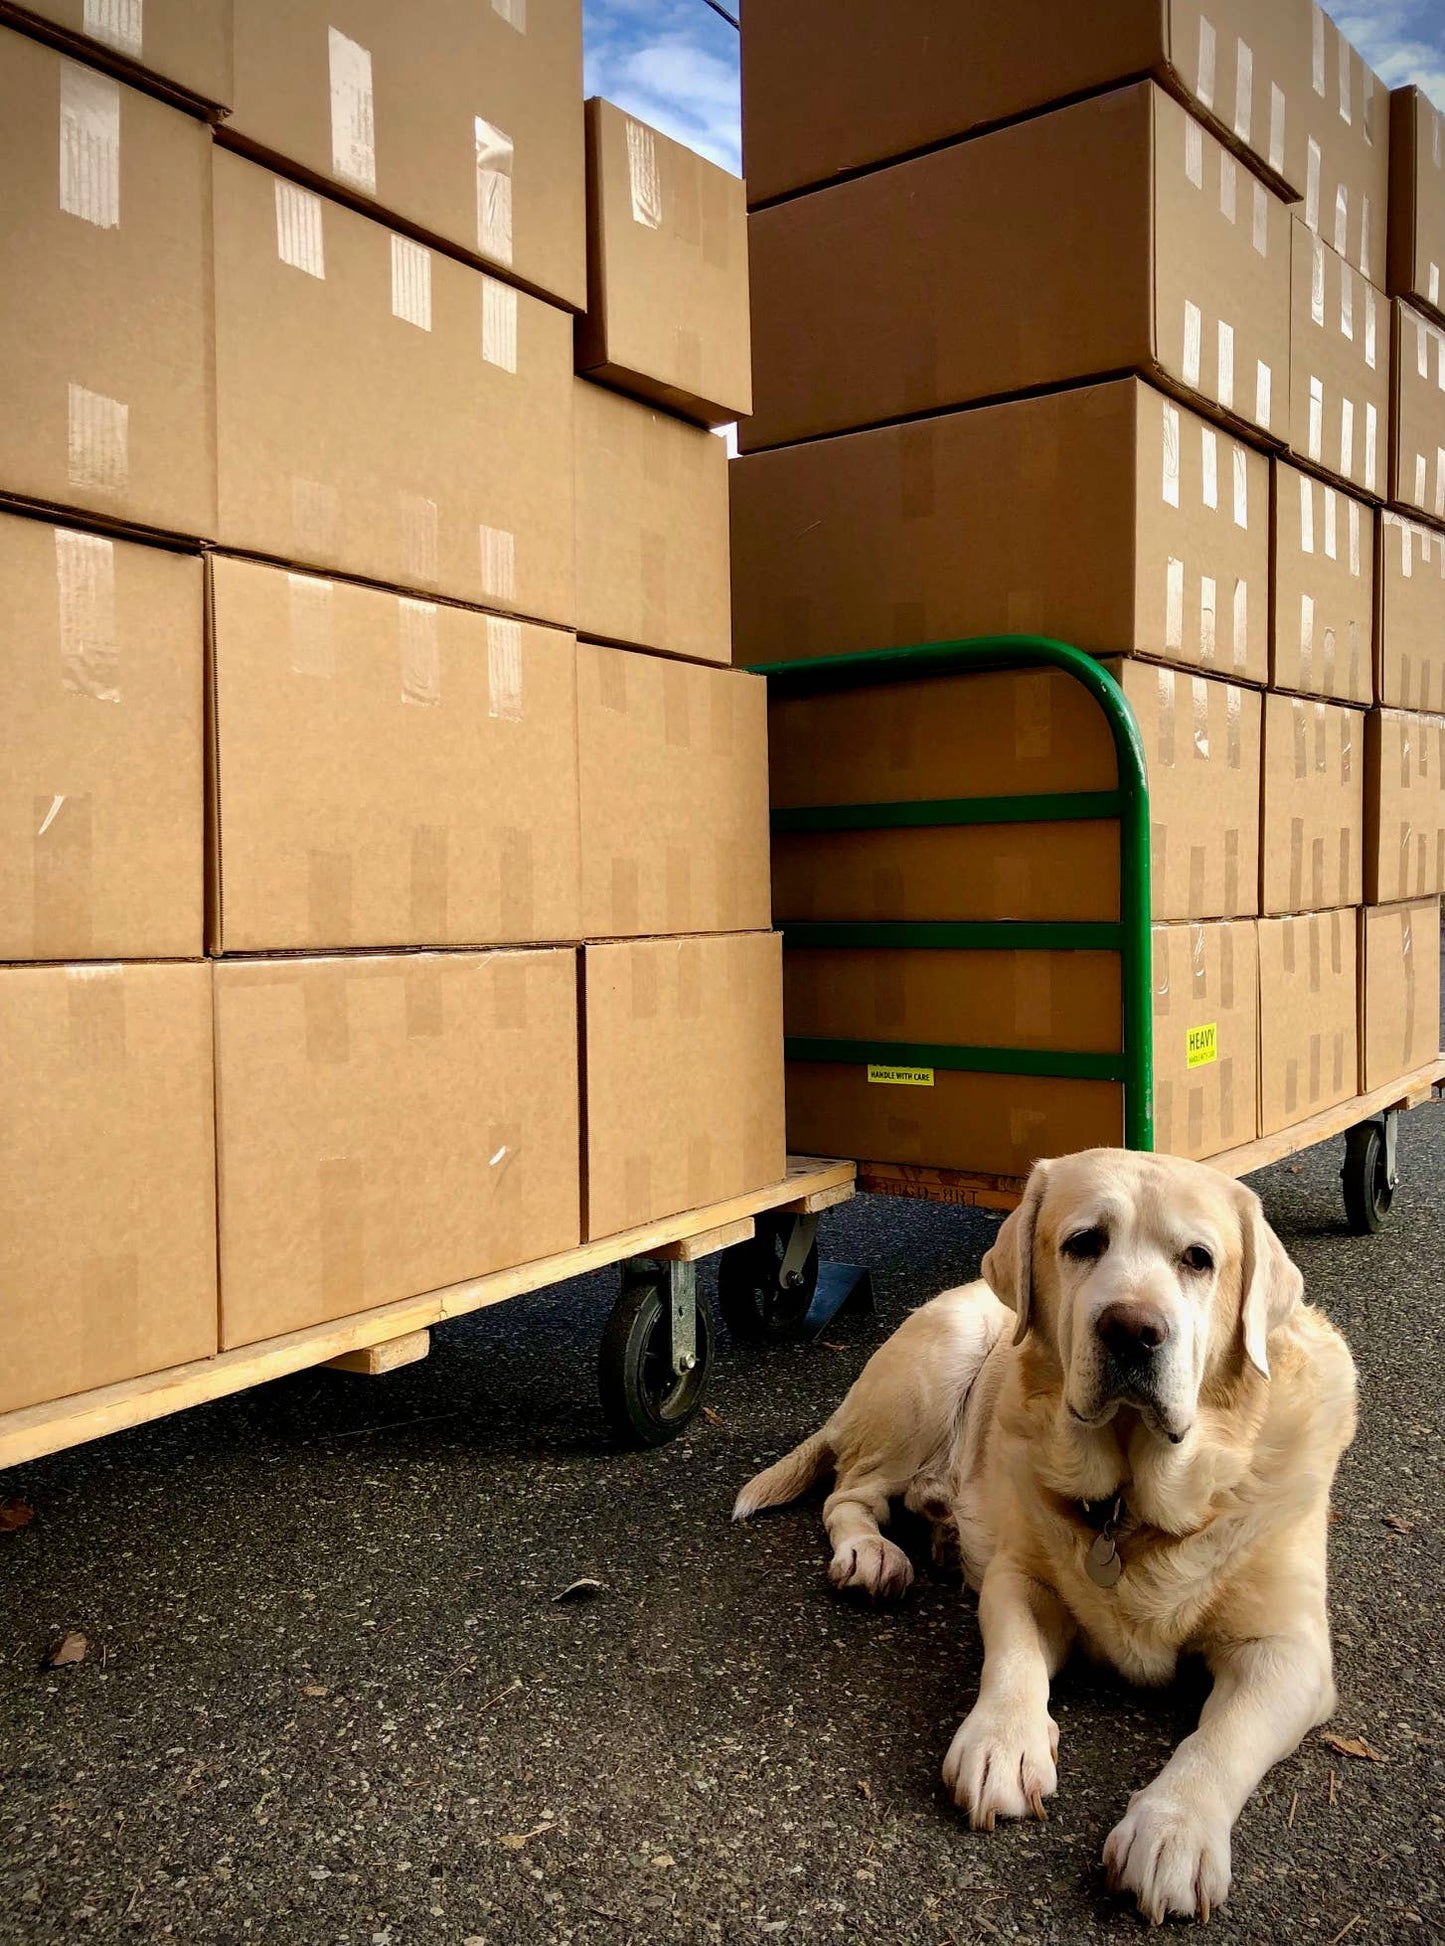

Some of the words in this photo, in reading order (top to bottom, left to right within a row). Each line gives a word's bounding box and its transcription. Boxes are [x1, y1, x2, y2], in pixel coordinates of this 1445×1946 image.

[1189, 1028, 1215, 1051] HEAVY
[870, 1071, 895, 1079] HANDLE
[896, 1072, 912, 1080] WITH
[913, 1073, 930, 1081] CARE
